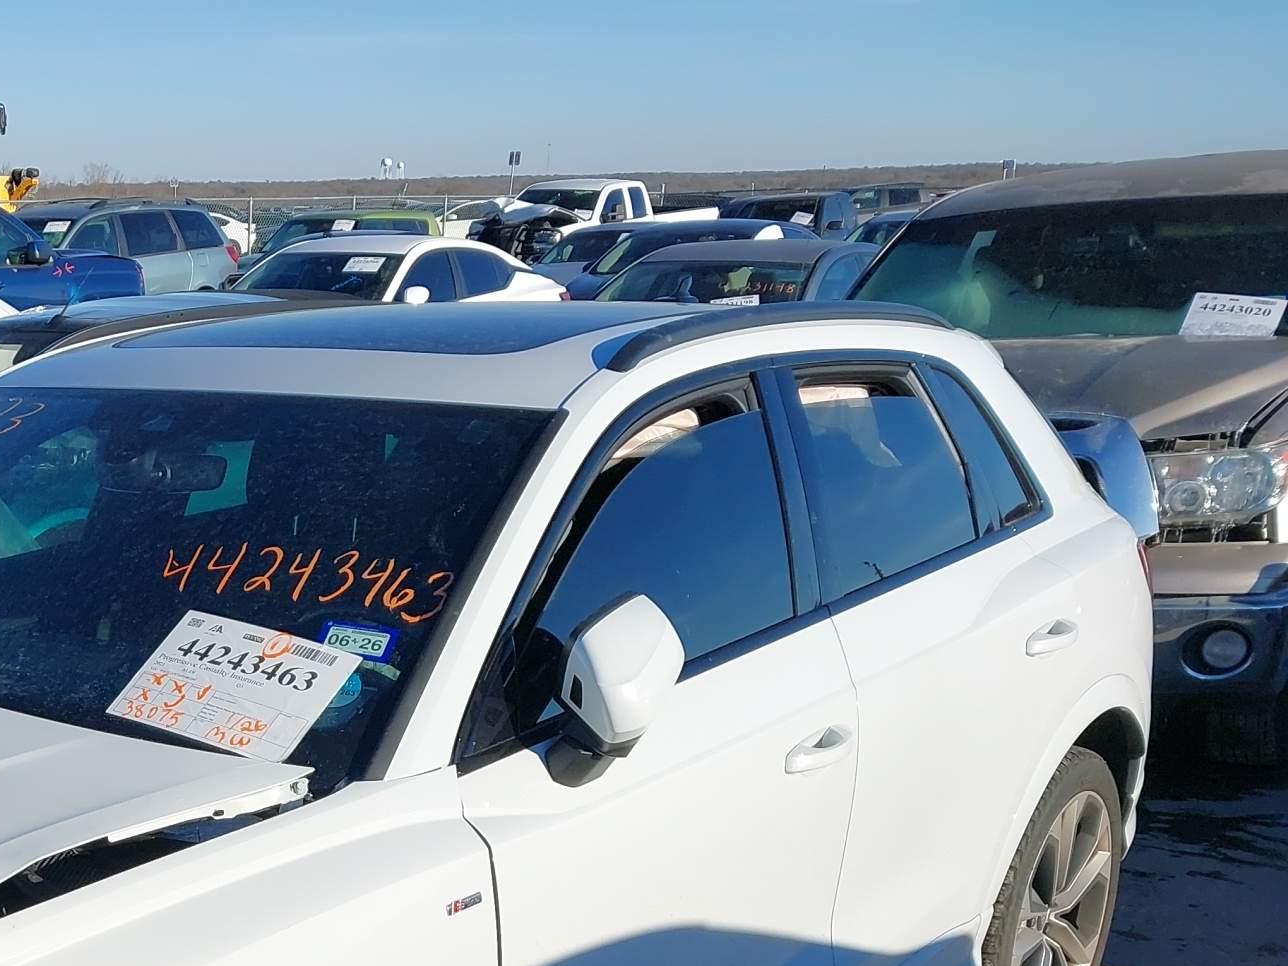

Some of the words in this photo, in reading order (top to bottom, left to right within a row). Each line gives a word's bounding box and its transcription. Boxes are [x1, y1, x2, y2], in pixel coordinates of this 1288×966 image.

[1199, 302, 1272, 317] 44243020
[163, 542, 454, 623] 44243463
[158, 652, 198, 668] Progressive
[199, 663, 230, 678] Casualty
[230, 672, 265, 687] Insurance
[177, 638, 318, 692] 44243463
[122, 700, 185, 728] 38075
